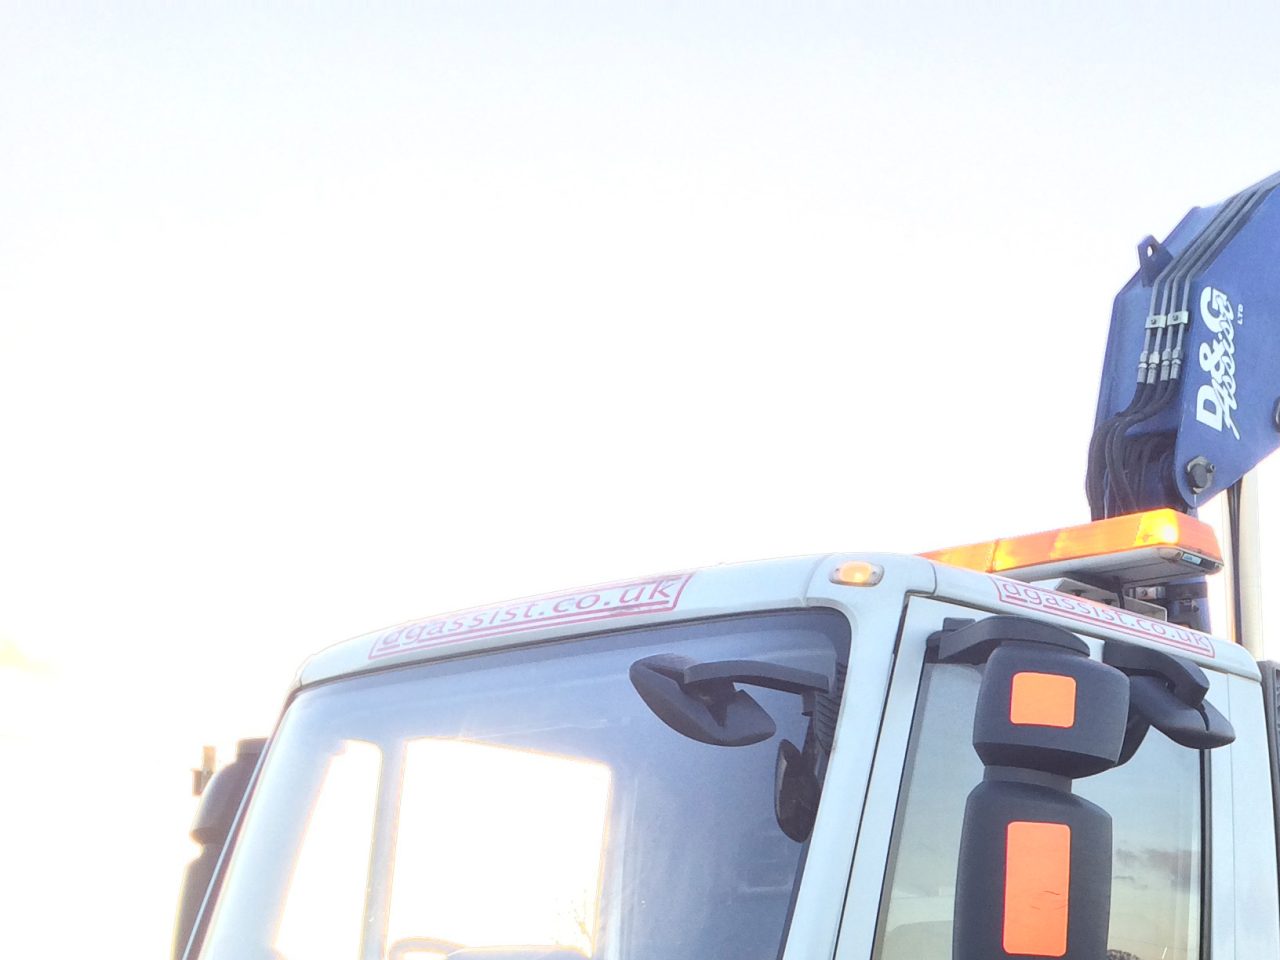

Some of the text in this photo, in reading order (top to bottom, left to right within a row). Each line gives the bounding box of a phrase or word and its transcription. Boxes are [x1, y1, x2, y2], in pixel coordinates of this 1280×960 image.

[1196, 286, 1228, 432] D&G
[381, 579, 674, 647] dgassist.co.uk
[1002, 580, 1210, 647] dgassist.co.uk
